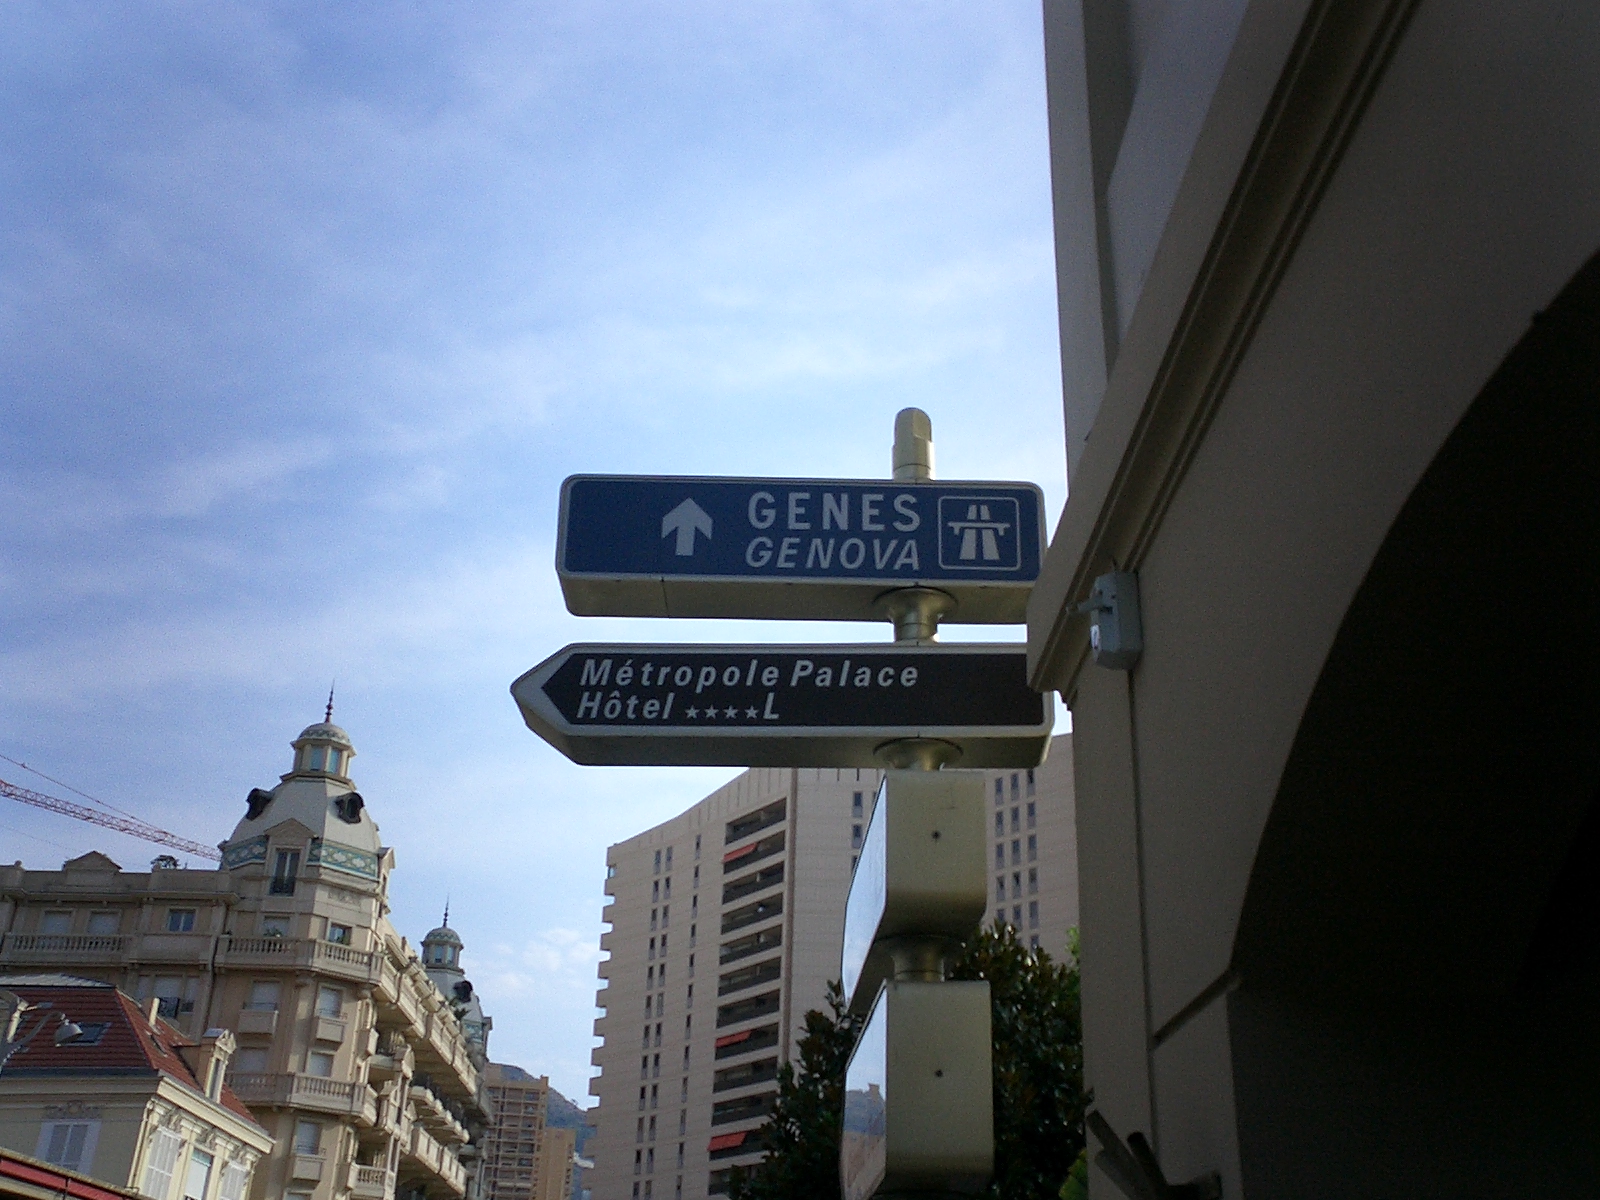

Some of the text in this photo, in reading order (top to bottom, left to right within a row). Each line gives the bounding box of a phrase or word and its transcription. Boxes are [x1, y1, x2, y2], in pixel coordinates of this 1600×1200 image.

[747, 491, 921, 532] GENES
[745, 535, 920, 571] GENOVA
[579, 658, 919, 694] Métropole Palace
[576, 690, 676, 720] Hôtel
